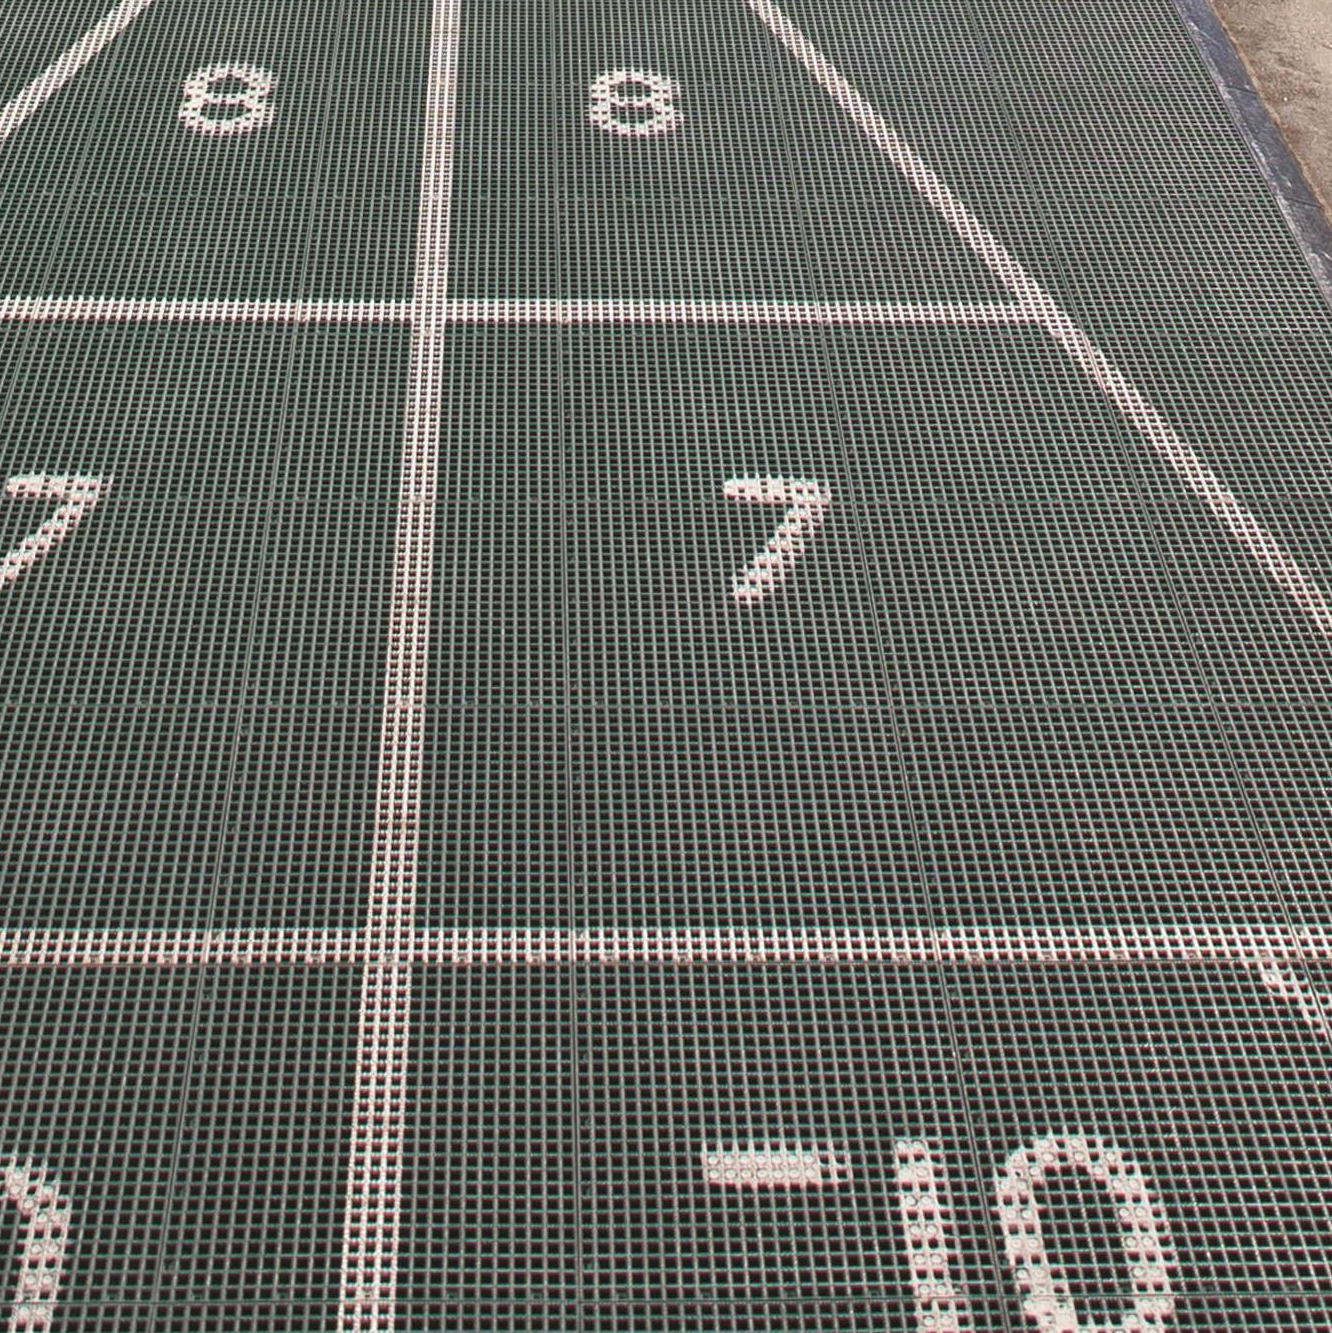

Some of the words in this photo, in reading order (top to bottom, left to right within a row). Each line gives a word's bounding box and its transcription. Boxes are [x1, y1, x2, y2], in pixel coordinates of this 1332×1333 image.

[178, 62, 275, 137] 8
[588, 68, 683, 138] 8
[722, 476, 831, 603] 7
